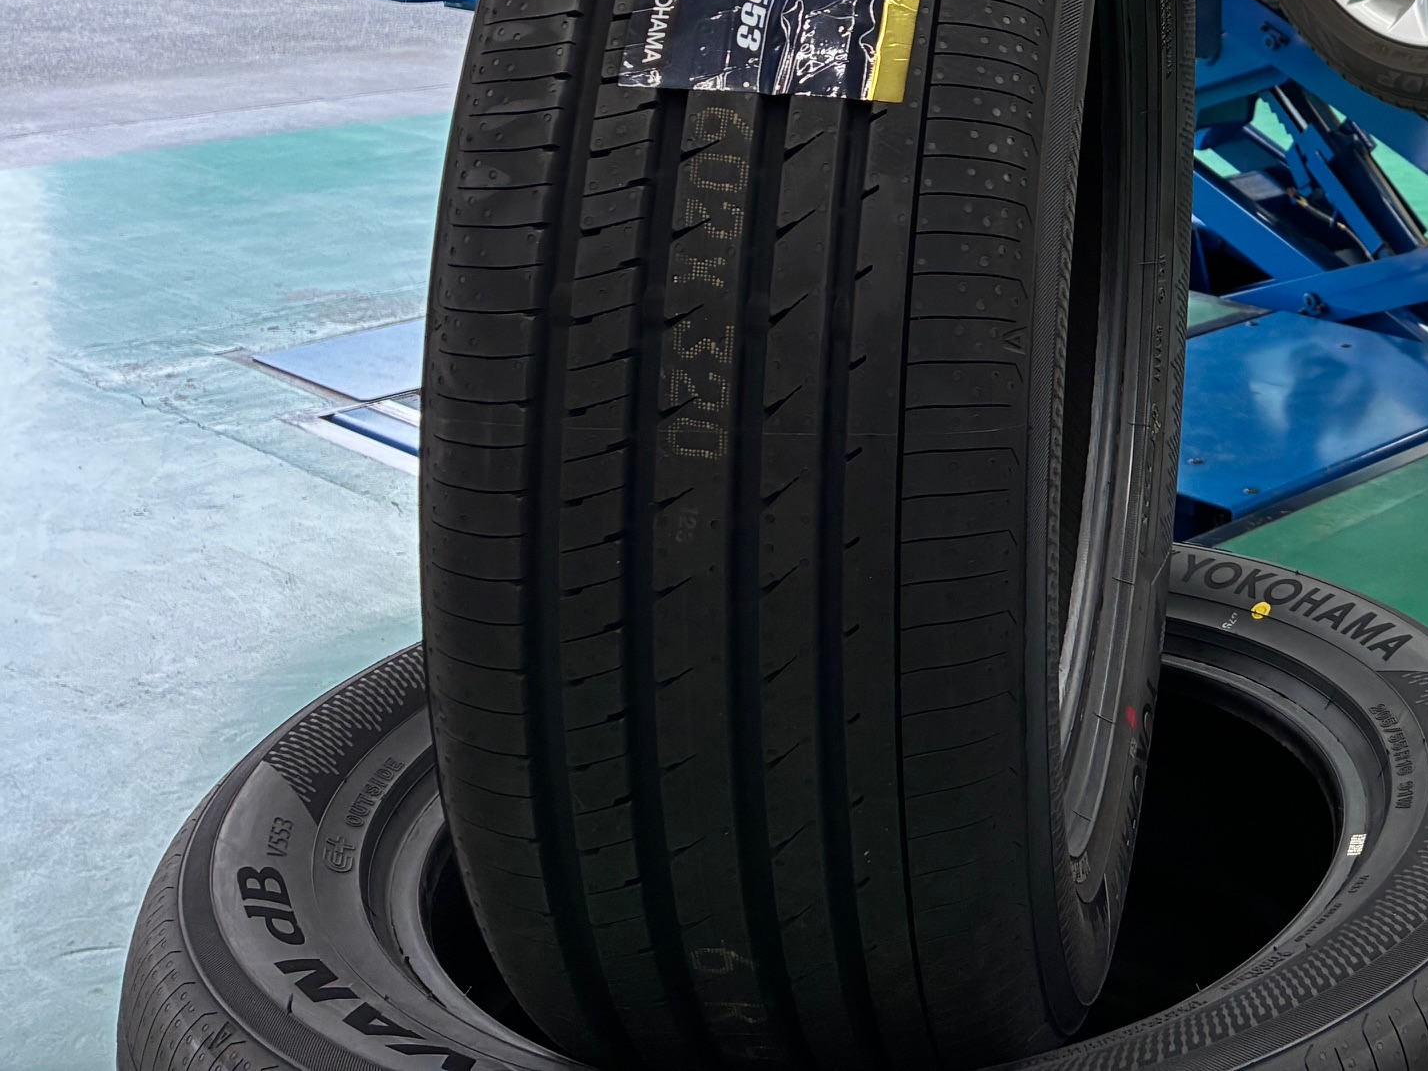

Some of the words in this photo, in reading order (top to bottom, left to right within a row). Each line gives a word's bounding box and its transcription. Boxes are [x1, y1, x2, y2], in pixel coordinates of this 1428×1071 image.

[1181, 553, 1414, 662] YOKOHAMA
[346, 756, 405, 828] OUTSIDE
[266, 816, 294, 858] V553
[236, 866, 305, 946] dB
